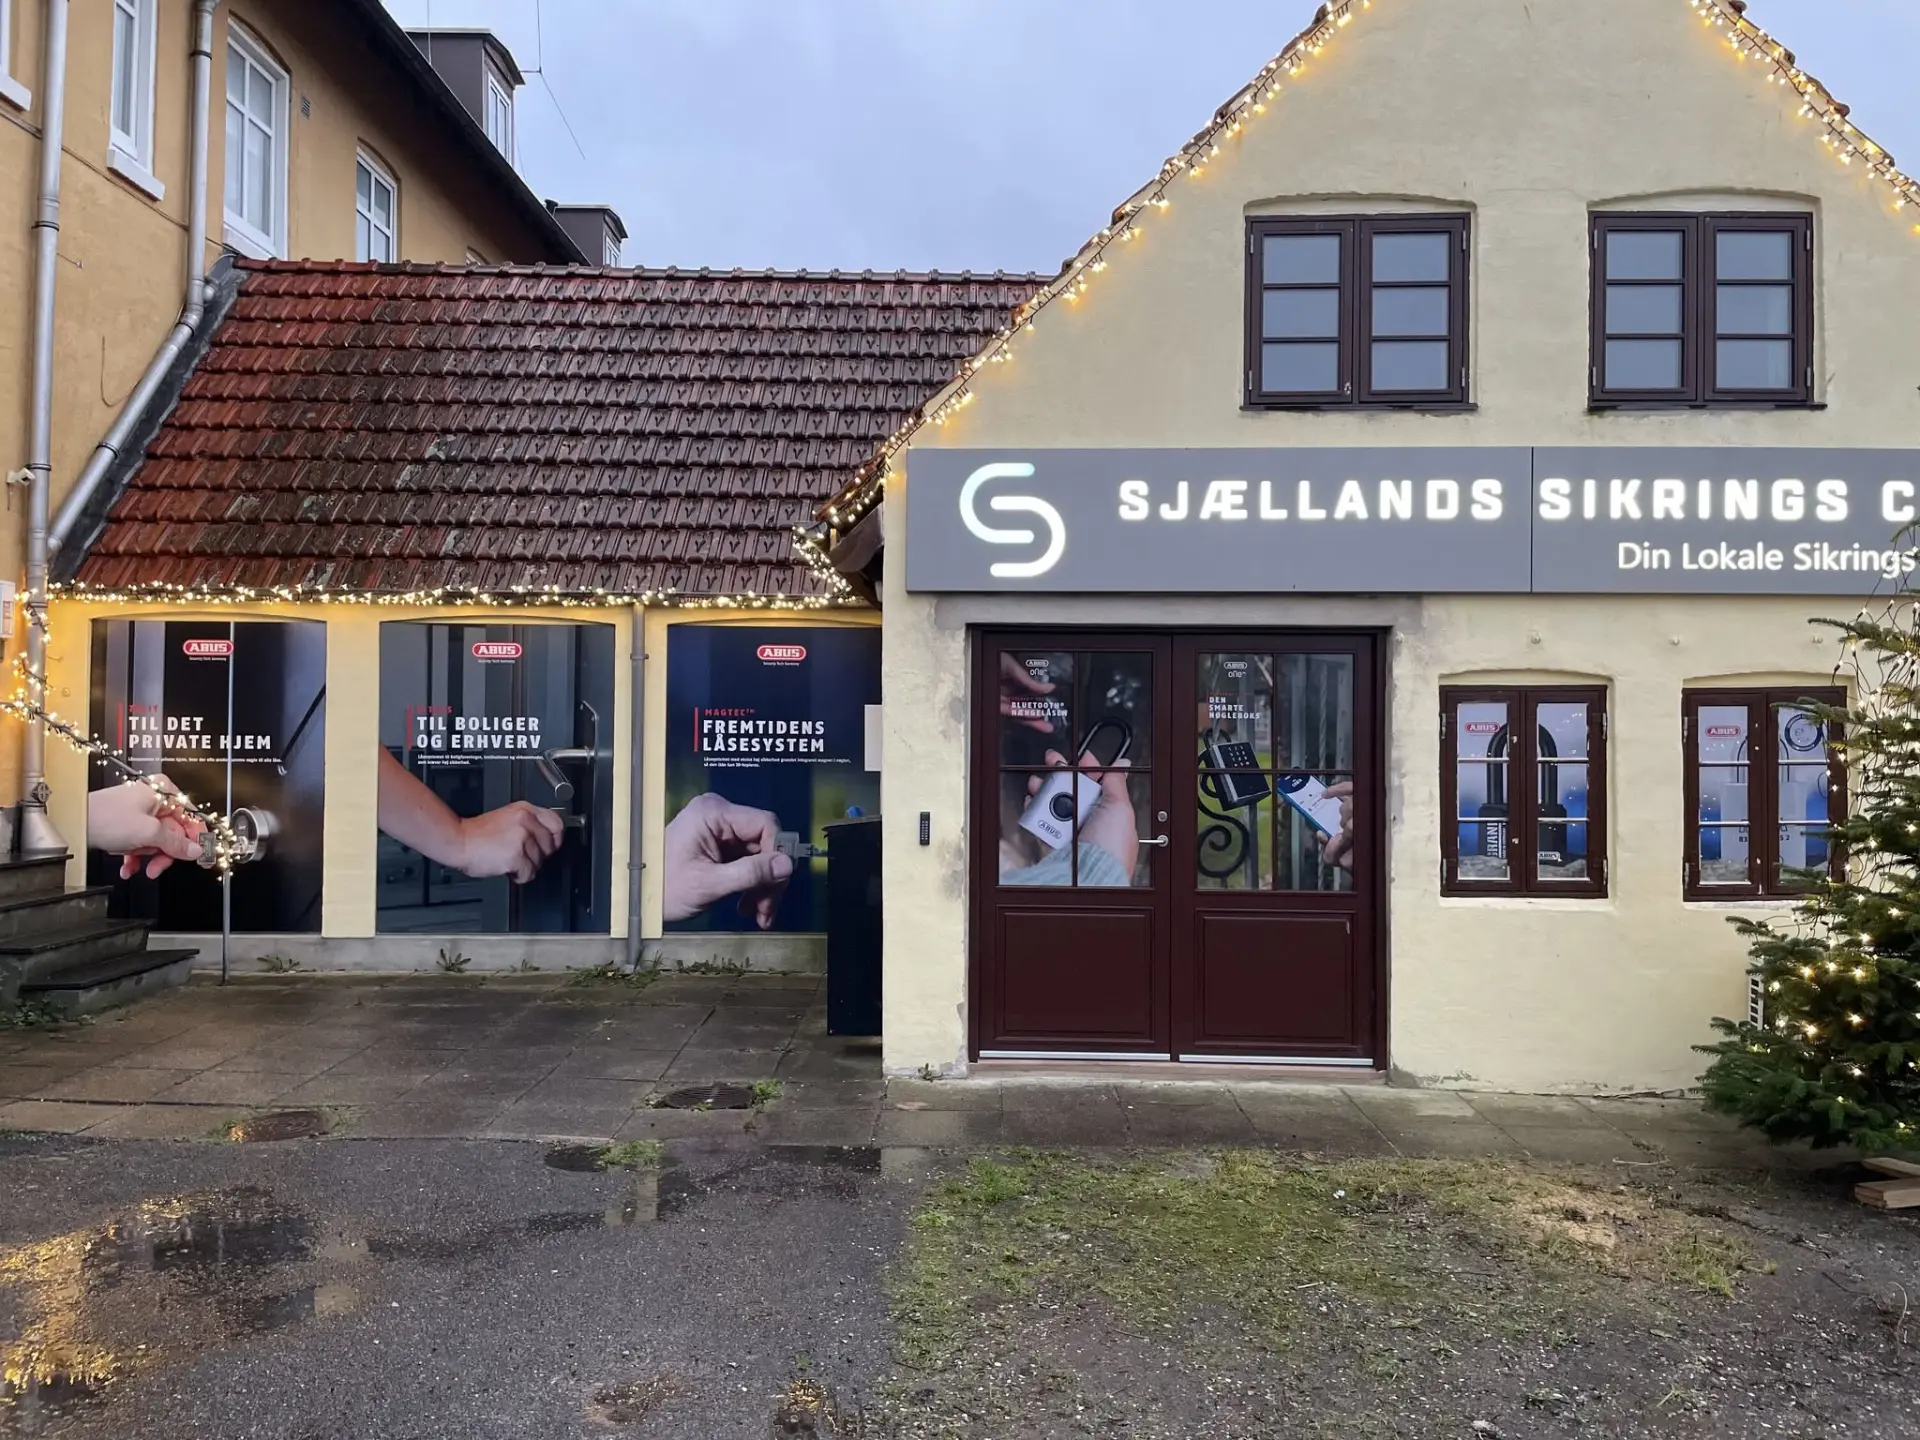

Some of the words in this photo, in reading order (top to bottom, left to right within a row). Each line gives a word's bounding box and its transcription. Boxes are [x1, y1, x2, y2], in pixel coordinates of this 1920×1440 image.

[1118, 479, 1503, 520] SJÆLLANDS
[1539, 478, 1849, 521] SIKRINGS
[1618, 541, 1670, 569] Din
[1682, 541, 1784, 570] Lokale
[189, 643, 228, 653] ABUS
[478, 645, 516, 655] ABUS
[763, 648, 800, 658] ABUS
[129, 716, 159, 731] TIL
[167, 716, 204, 731] DET
[416, 716, 447, 731] TIL
[455, 716, 539, 731] BOLIGER
[703, 719, 824, 735] FREMTIDENS
[129, 734, 211, 749] PRIVATE
[219, 735, 271, 750] HJEM
[416, 734, 442, 749] OG
[451, 734, 541, 749] ERHVERV
[703, 733, 824, 752] LÅSESYSTEM
